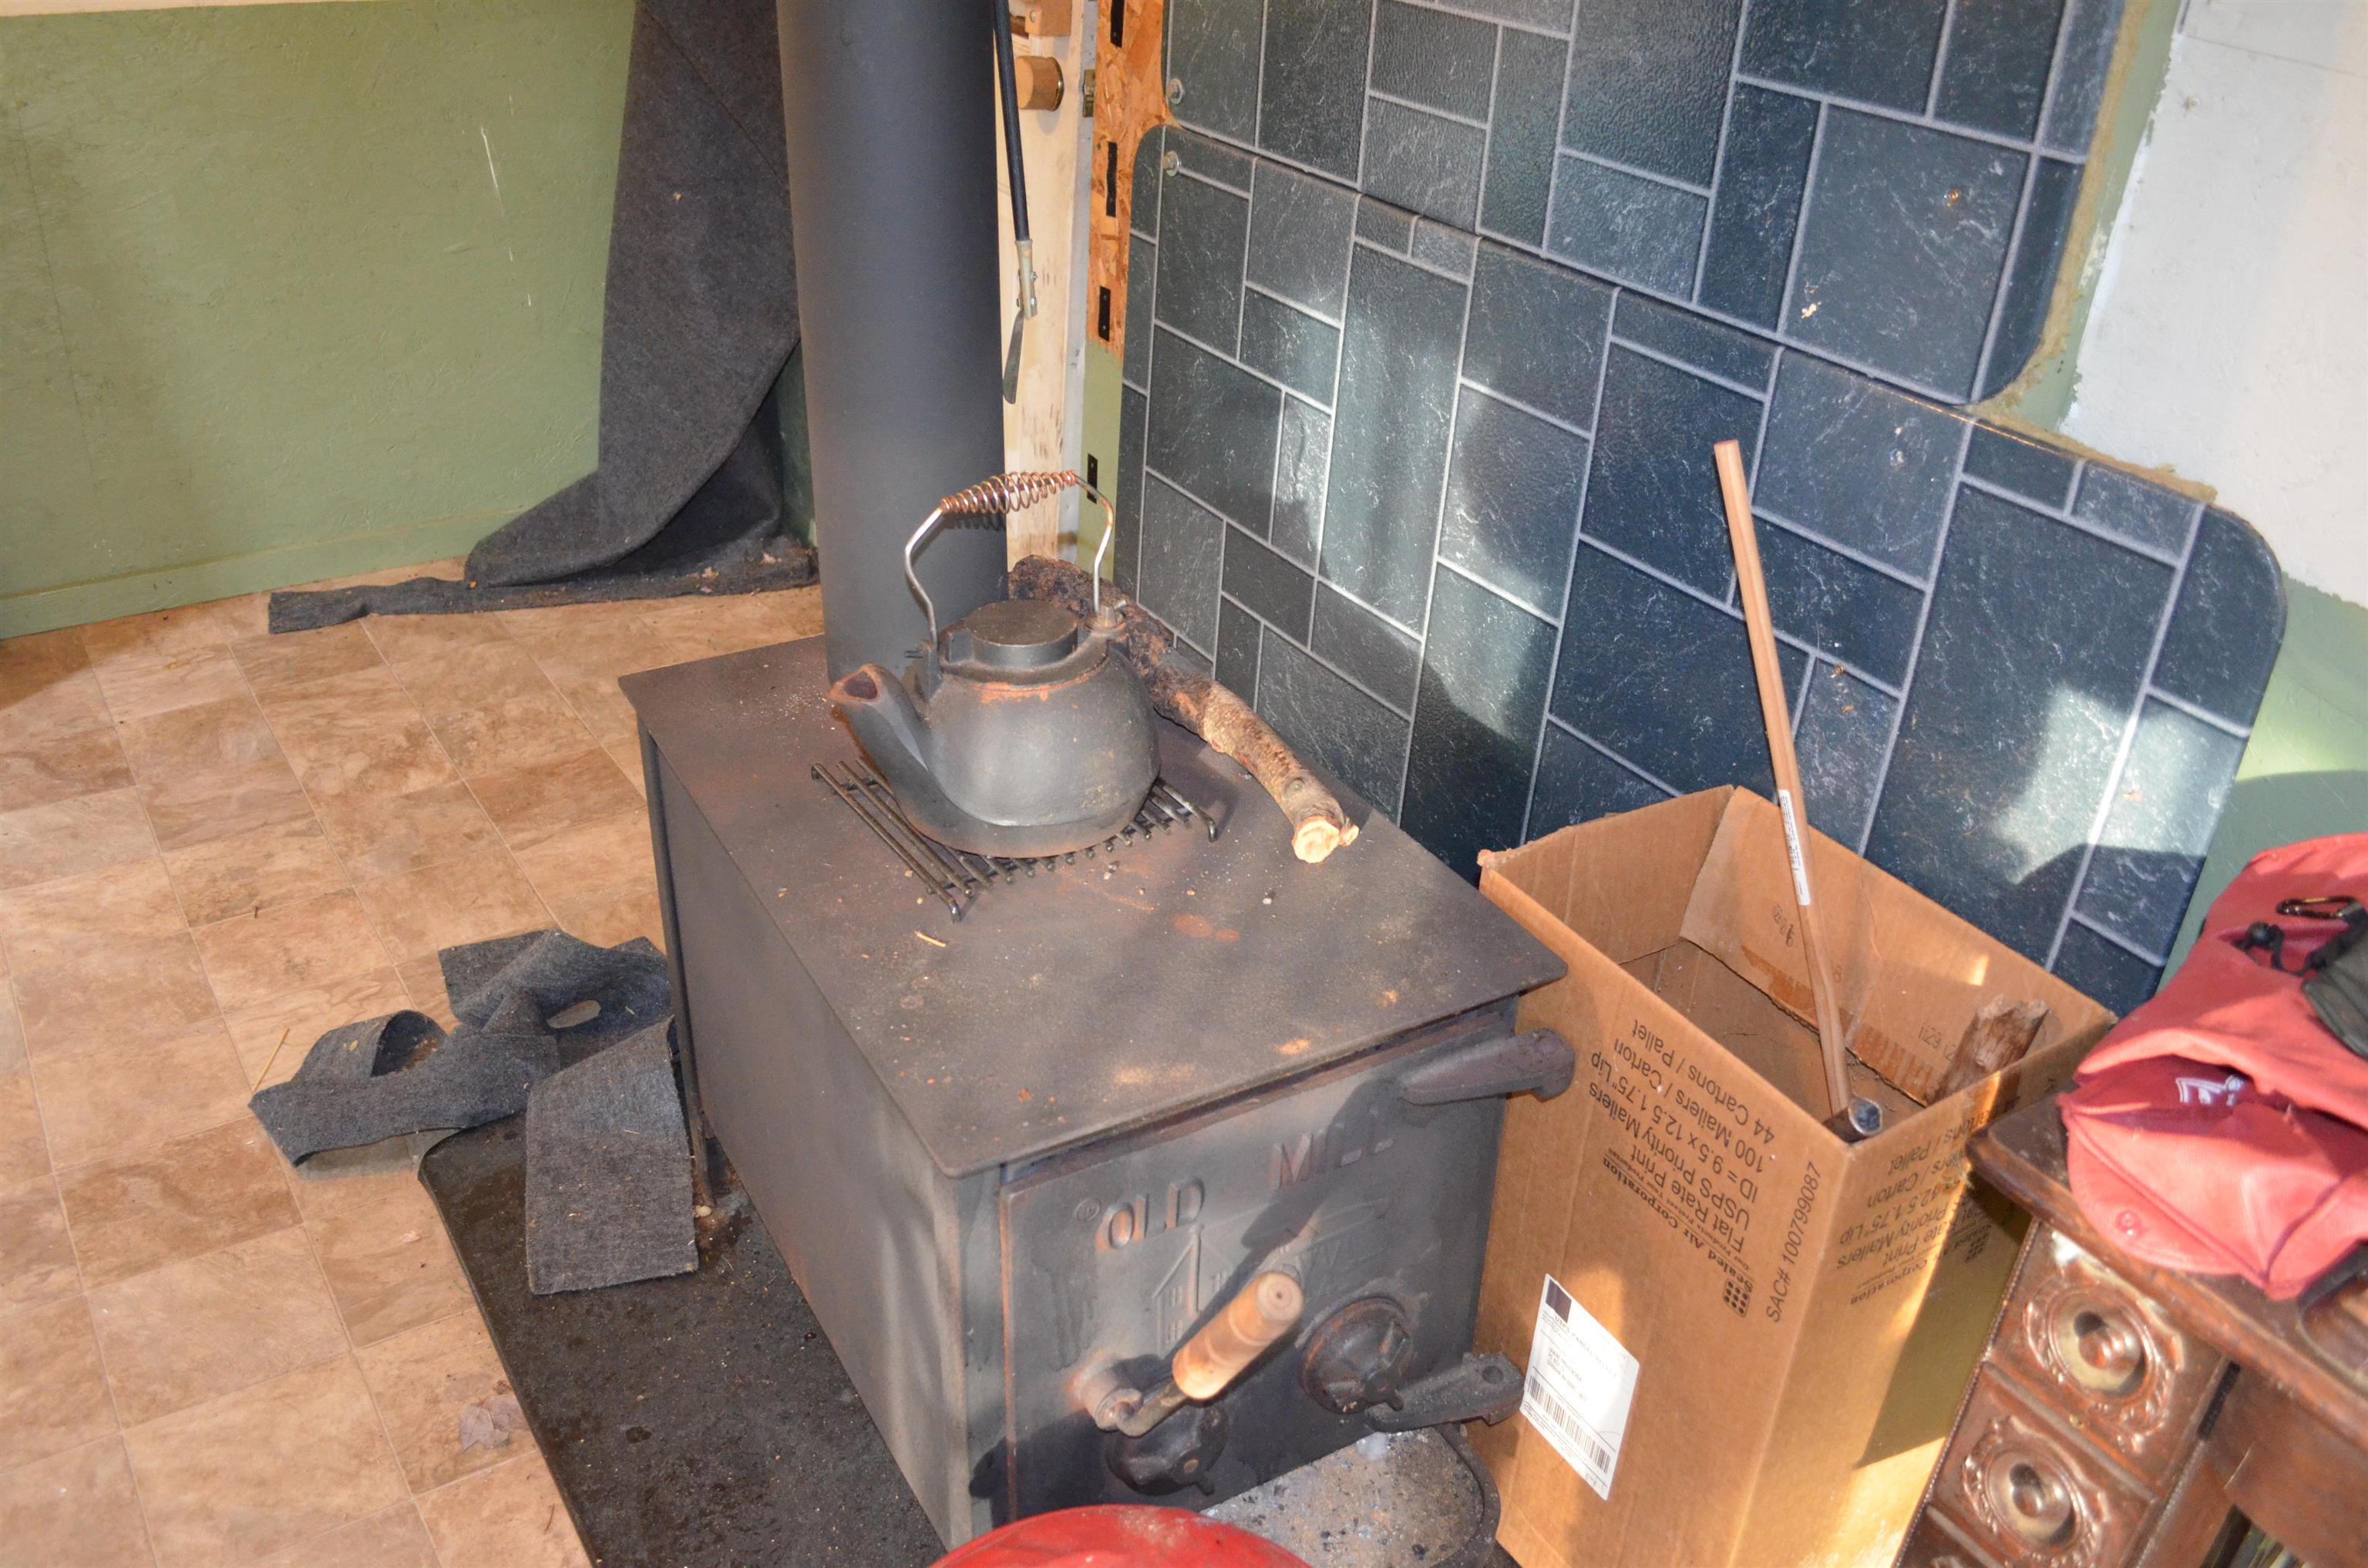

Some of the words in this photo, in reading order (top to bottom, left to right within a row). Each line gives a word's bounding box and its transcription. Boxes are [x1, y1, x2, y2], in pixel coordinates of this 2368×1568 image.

[1633, 1020, 1674, 1067] Pallet
[1591, 1052, 1613, 1082] Lip
[1614, 1038, 1662, 1090] Carton
[1677, 1058, 1686, 1074] /
[1663, 1082, 1673, 1098] /
[1689, 1065, 1749, 1126] Cartons
[1589, 1082, 1641, 1139] Mailers
[1653, 1105, 1683, 1141] 12.5
[1676, 1089, 1732, 1148] Mailers
[1943, 1110, 1990, 1143] artons
[1687, 1133, 1698, 1148] x
[1754, 1119, 1774, 1143] 44
[1631, 1145, 1667, 1189] Print
[1642, 1126, 1696, 1186] Priority
[1698, 1143, 1722, 1175] 9.5
[1735, 1139, 1763, 1173] 100
[1889, 1140, 1932, 1173] Pallet
[1603, 1156, 1679, 1230] Corporation
[1727, 1169, 1738, 1183] =
[1740, 1178, 1758, 1203] ID
[1867, 1172, 1919, 1209] Carton
[1095, 1176, 1206, 1253] OLD
[1671, 1180, 1709, 1223] Rate
[1699, 1178, 1750, 1231] USPS
[1899, 1202, 1949, 1237] Priority
[1683, 1228, 1705, 1250] Air
[1712, 1213, 1744, 1253] Flat
[1765, 1266, 1792, 1323] SAC#
[1781, 1160, 1822, 1266] 100799087
[1837, 1230, 1893, 1270] Mailers
[1840, 1224, 1865, 1246] Lip
[1707, 1248, 1754, 1294] Sealed
[1883, 1241, 1918, 1267] Print
[1850, 1259, 1928, 1304] Corporation
